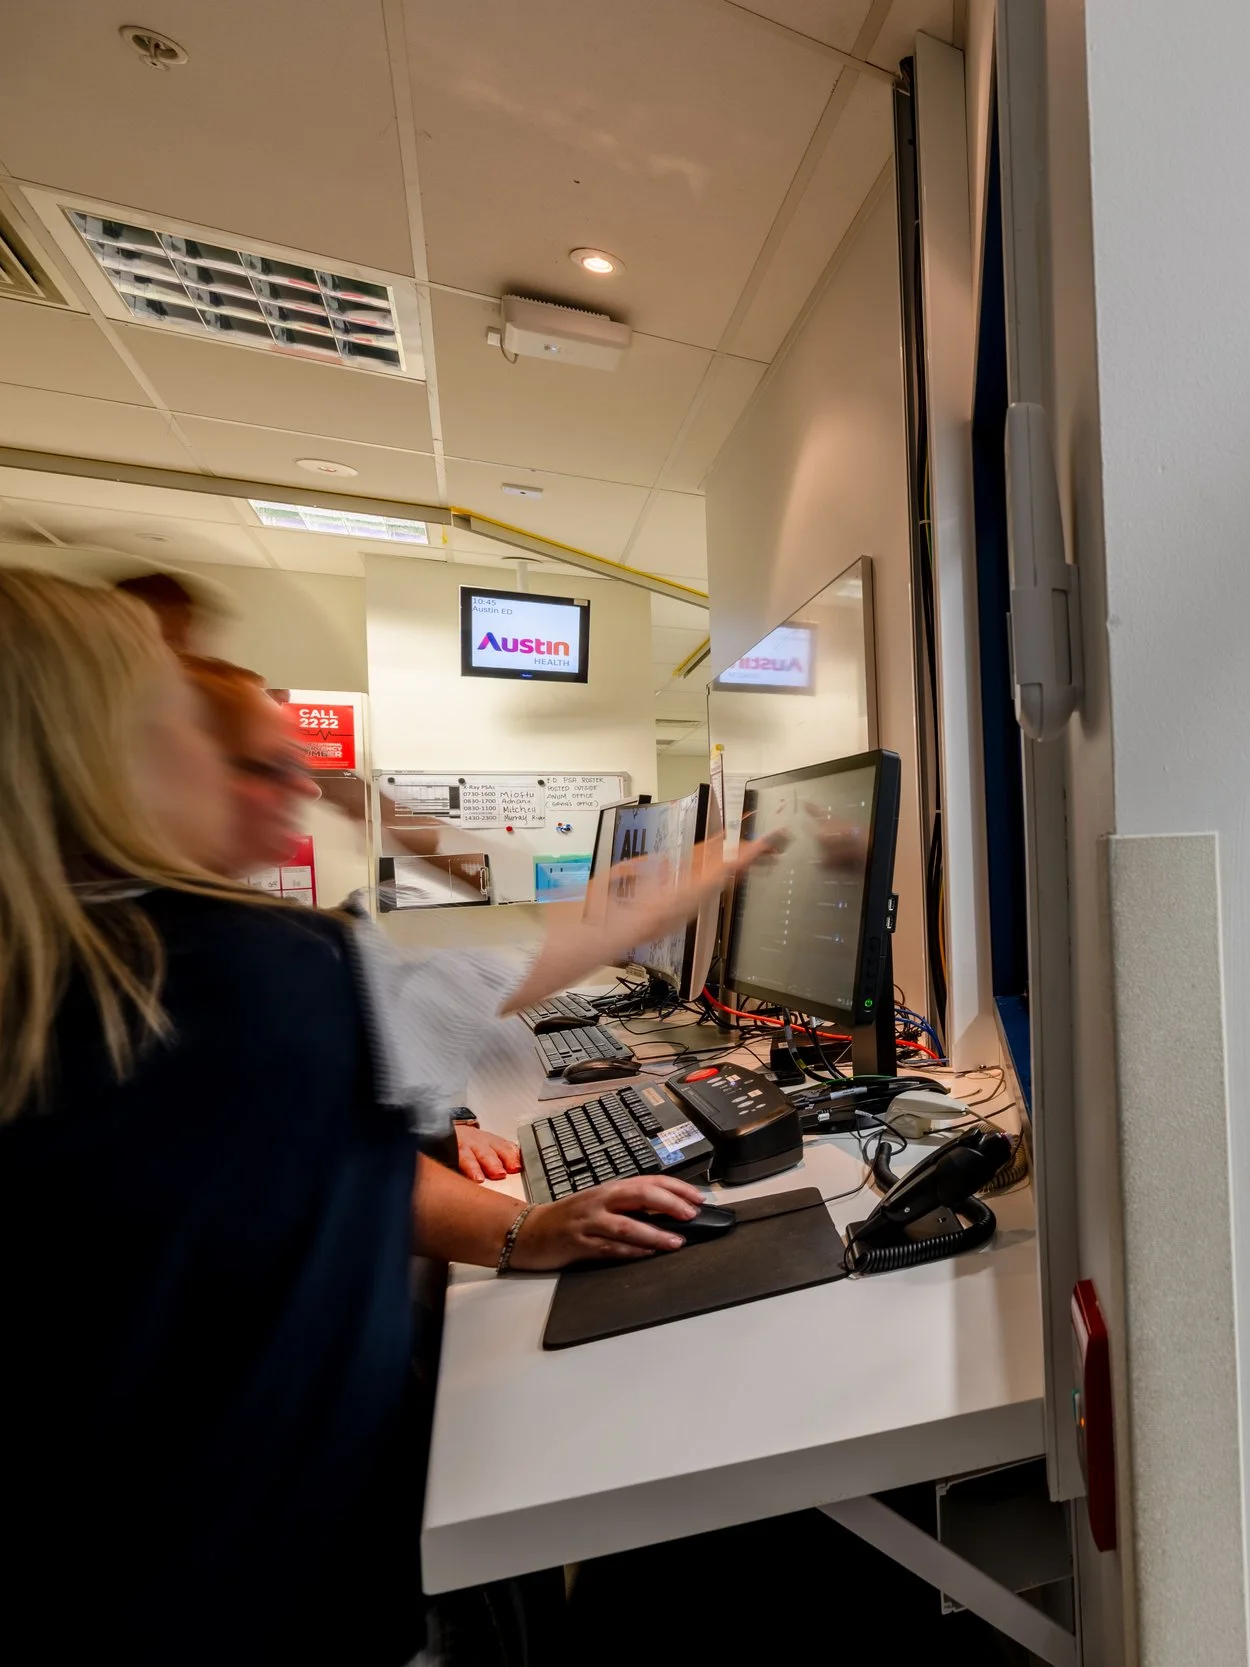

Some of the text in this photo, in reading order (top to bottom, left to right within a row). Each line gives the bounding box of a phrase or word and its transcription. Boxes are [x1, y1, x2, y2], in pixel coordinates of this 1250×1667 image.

[473, 598, 497, 606] 10:45
[472, 606, 499, 614] Austin
[477, 632, 570, 657] Austin
[534, 658, 570, 666] HEALTH
[299, 709, 339, 719] CALL
[299, 718, 339, 729] 2222
[619, 829, 649, 861] ALL
